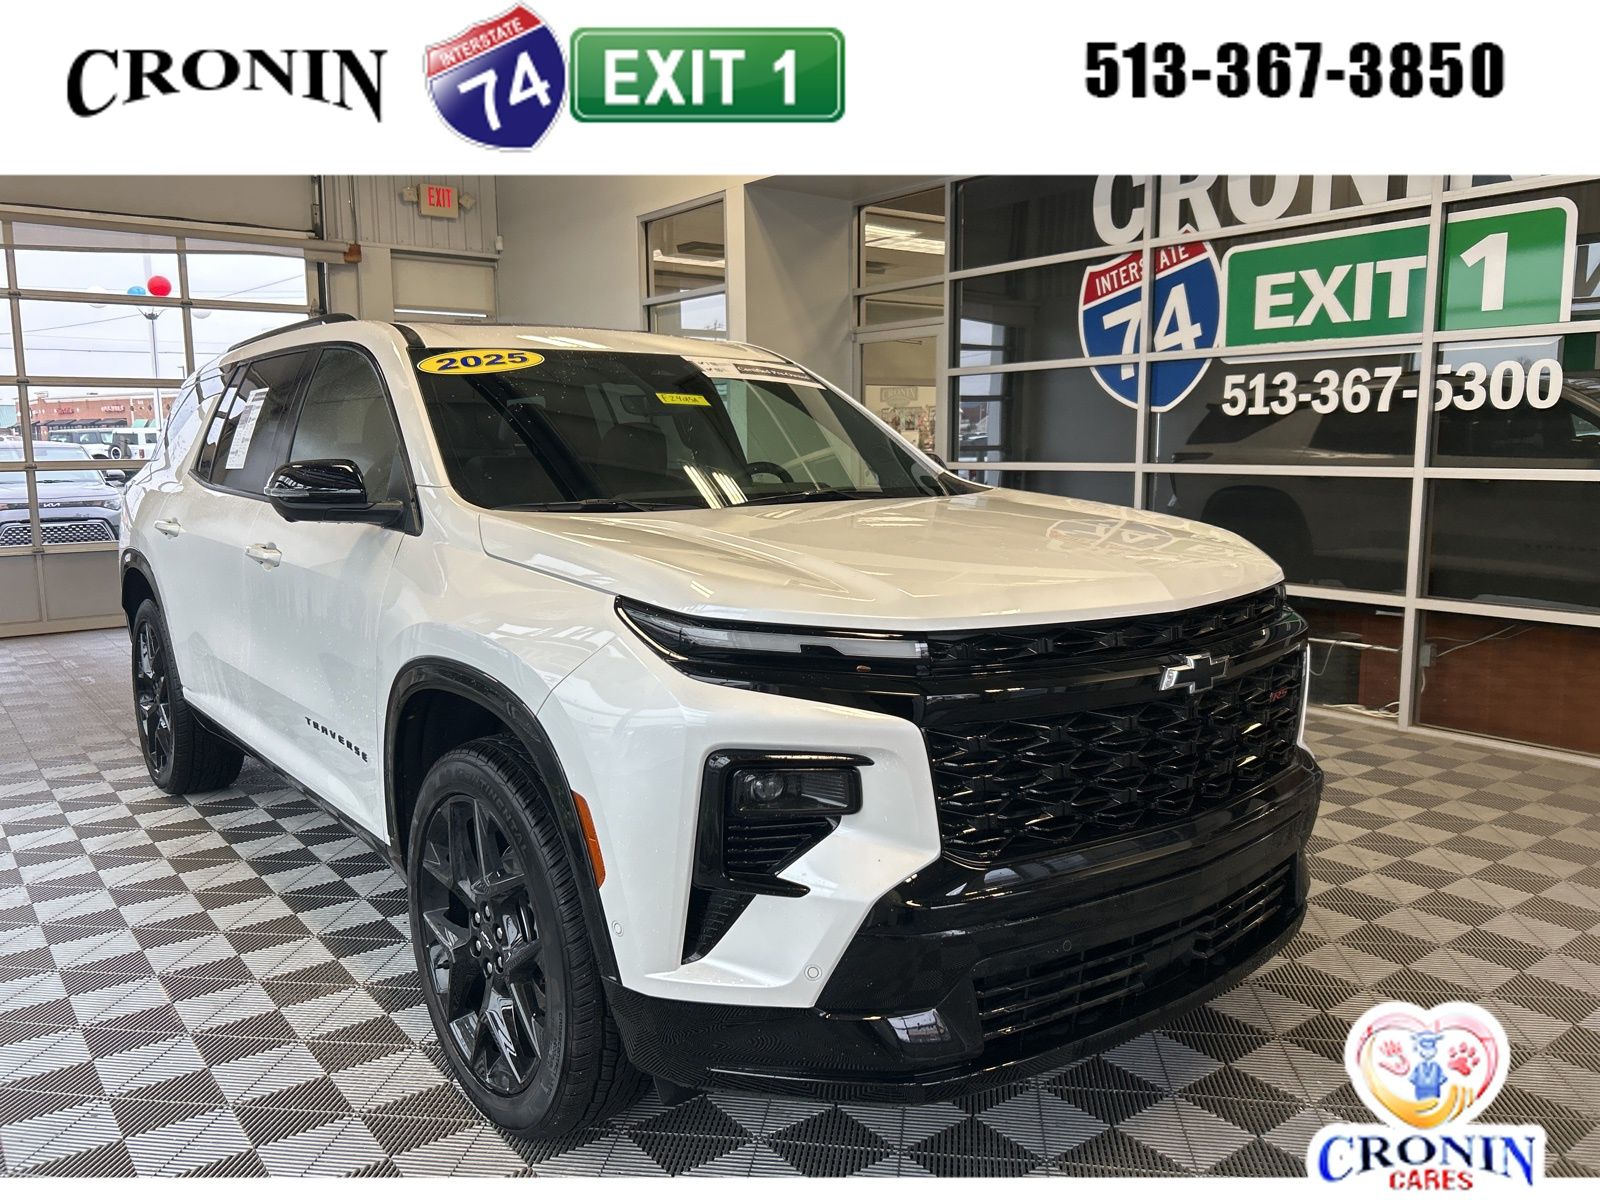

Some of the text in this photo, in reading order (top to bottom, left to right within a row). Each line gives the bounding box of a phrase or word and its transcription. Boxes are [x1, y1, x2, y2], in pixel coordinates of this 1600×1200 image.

[427, 186, 453, 208] EXIT
[1095, 244, 1189, 297] INTERATE
[1253, 255, 1427, 330] EXIT
[1459, 231, 1509, 312] 1
[1102, 282, 1203, 381] 74
[436, 352, 528, 371] 2025
[1221, 358, 1564, 417] 513-367-5300
[305, 716, 368, 762] TRAVERSE
